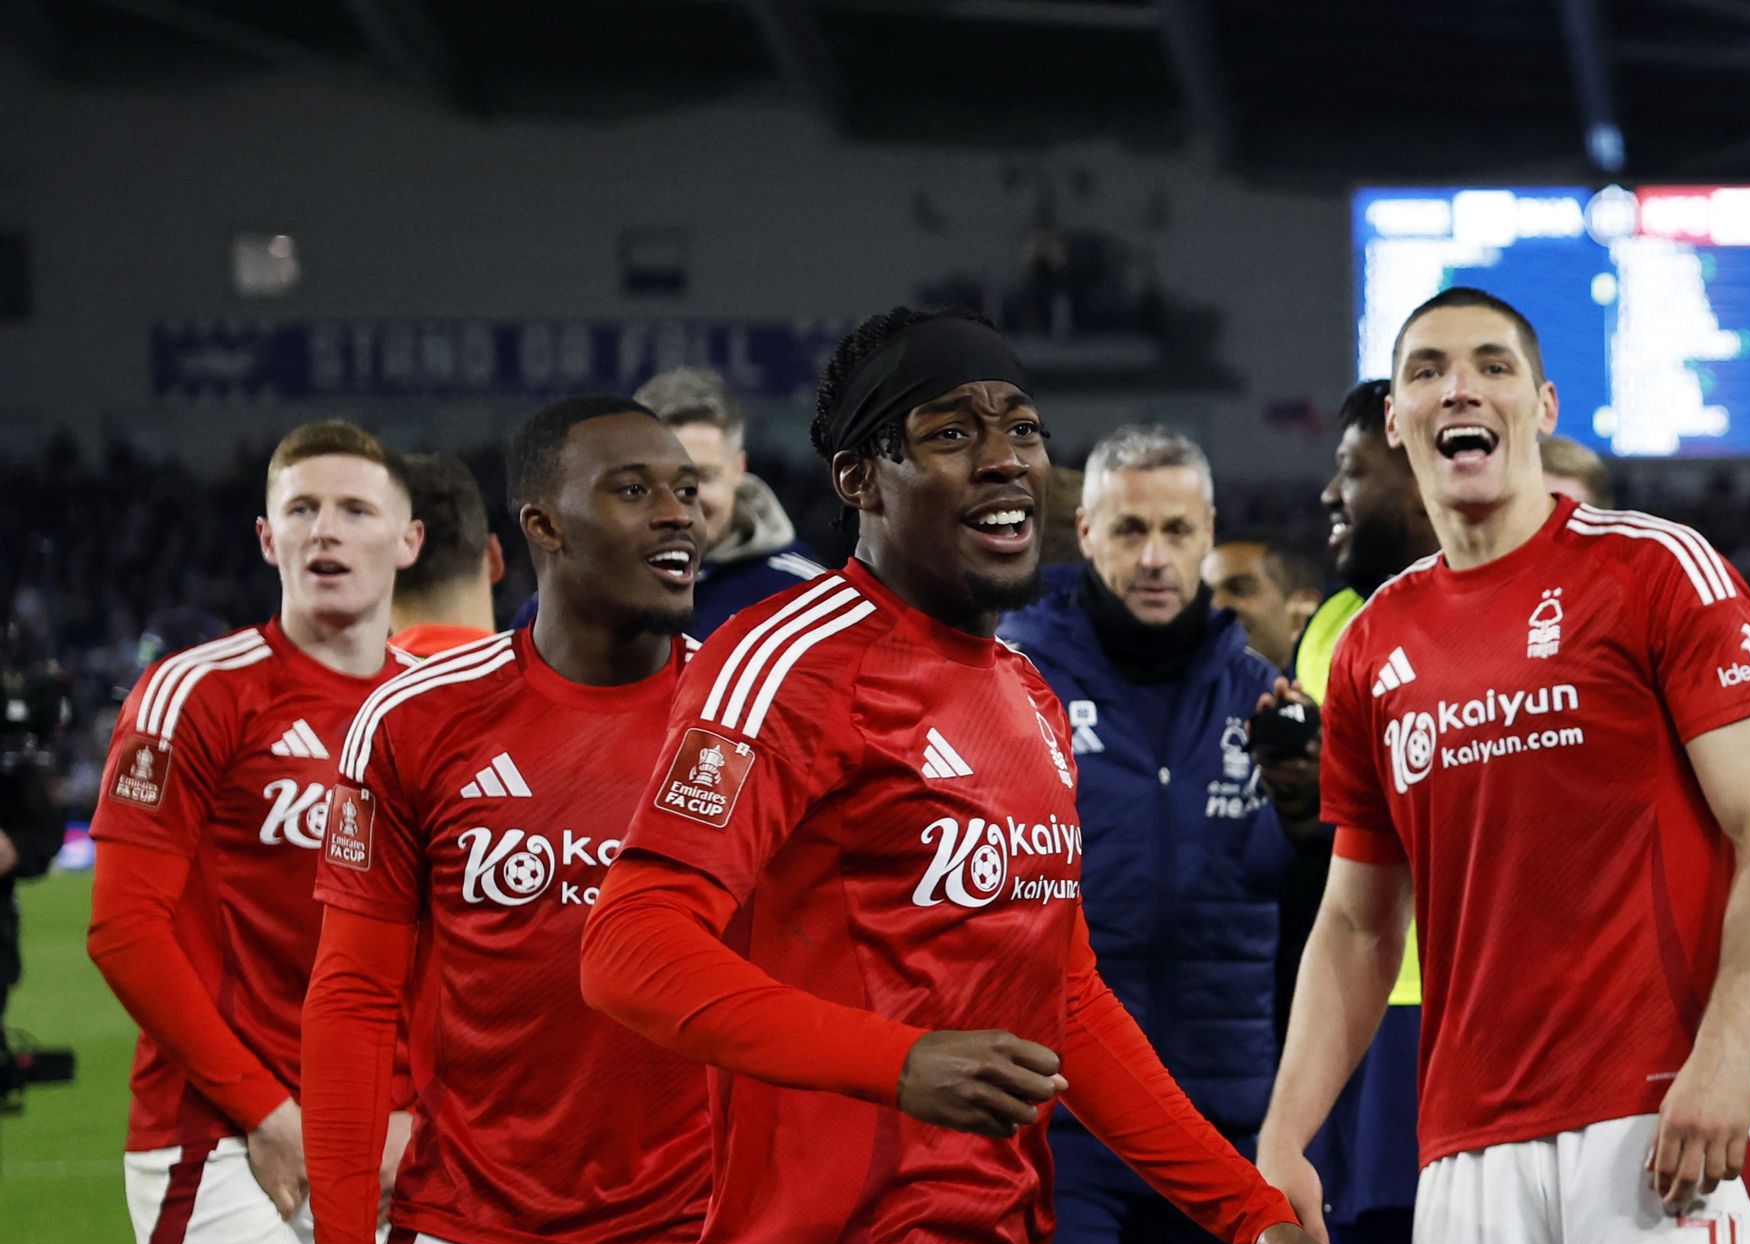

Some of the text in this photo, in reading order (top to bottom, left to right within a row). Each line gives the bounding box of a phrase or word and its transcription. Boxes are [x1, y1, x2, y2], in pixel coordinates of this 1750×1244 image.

[1437, 684, 1579, 734] kaiyun
[1441, 727, 1584, 769] kaiyun.com
[664, 791, 723, 816] FA CUP
[670, 781, 727, 805] Emirates
[343, 847, 365, 862] CUP
